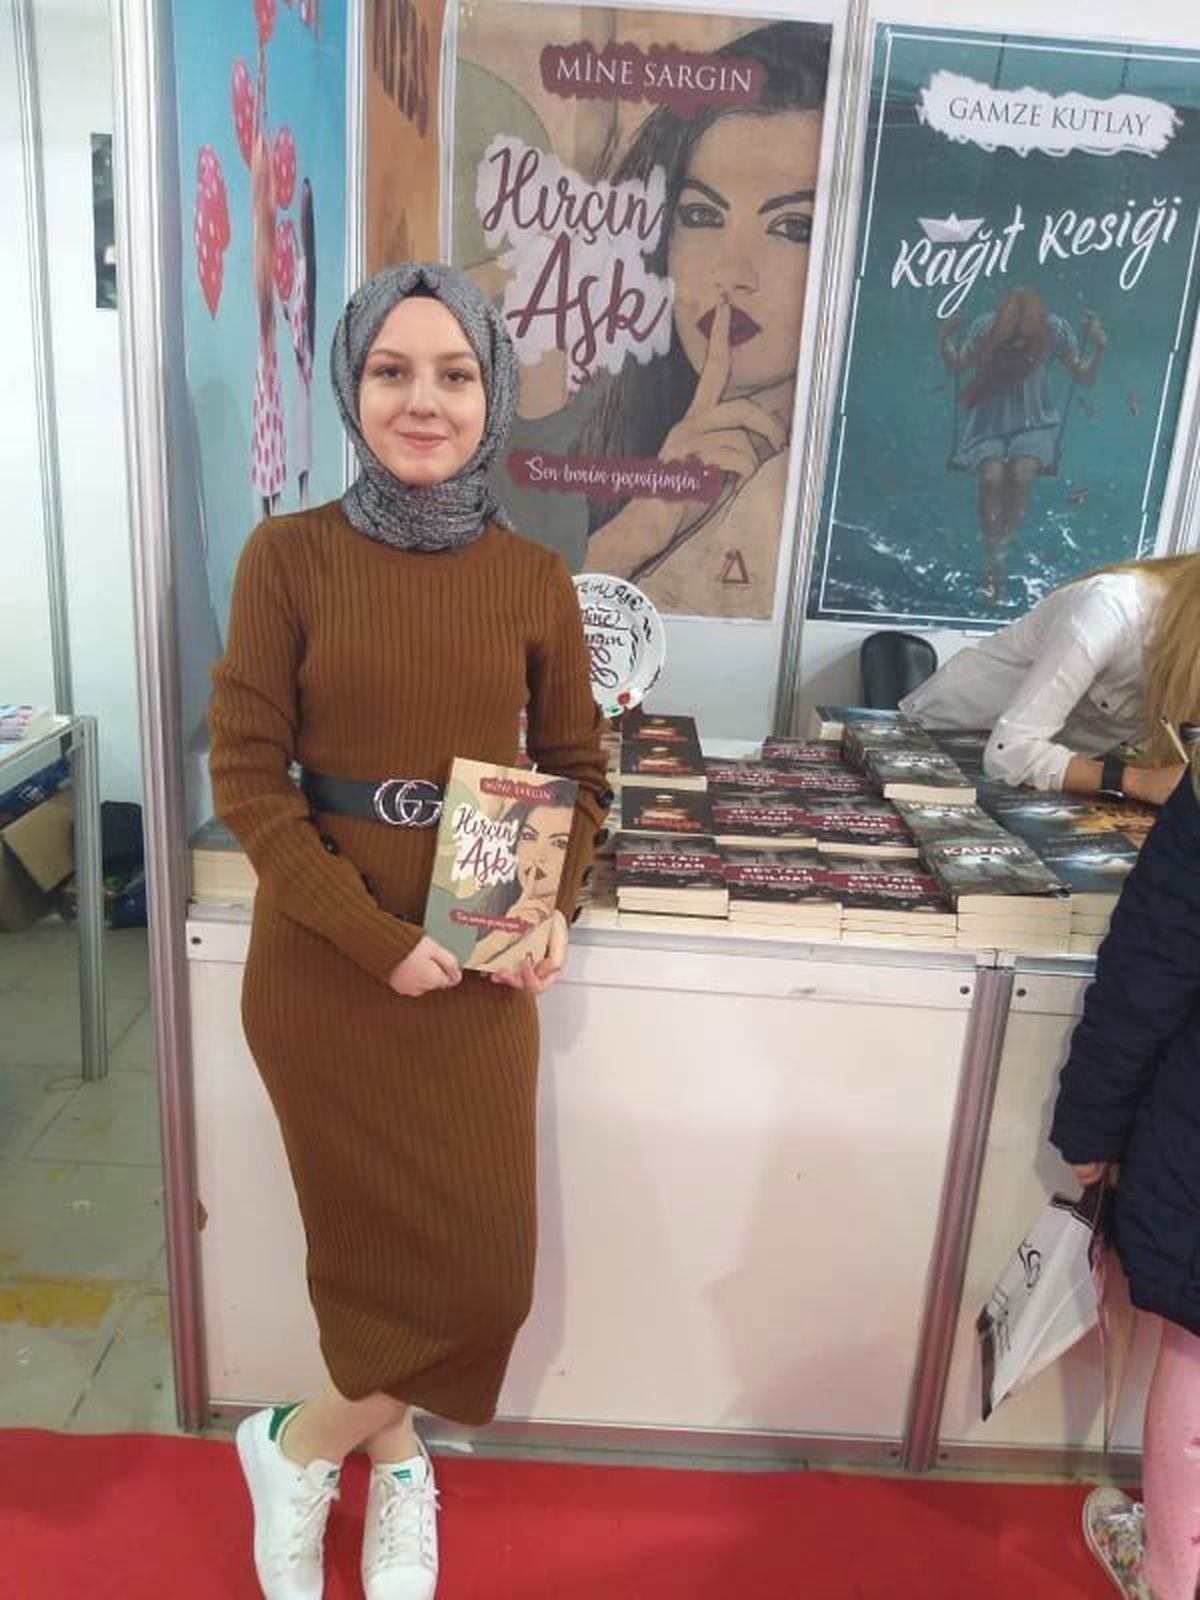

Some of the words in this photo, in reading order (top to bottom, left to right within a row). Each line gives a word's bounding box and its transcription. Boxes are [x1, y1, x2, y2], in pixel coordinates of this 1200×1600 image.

[556, 54, 633, 85] MİNE
[643, 62, 752, 92] SARGIN
[948, 97, 1041, 127] GAMZE
[1051, 106, 1151, 136] KUTLAY
[482, 147, 667, 245] Hırçın
[506, 231, 668, 384] Aşk
